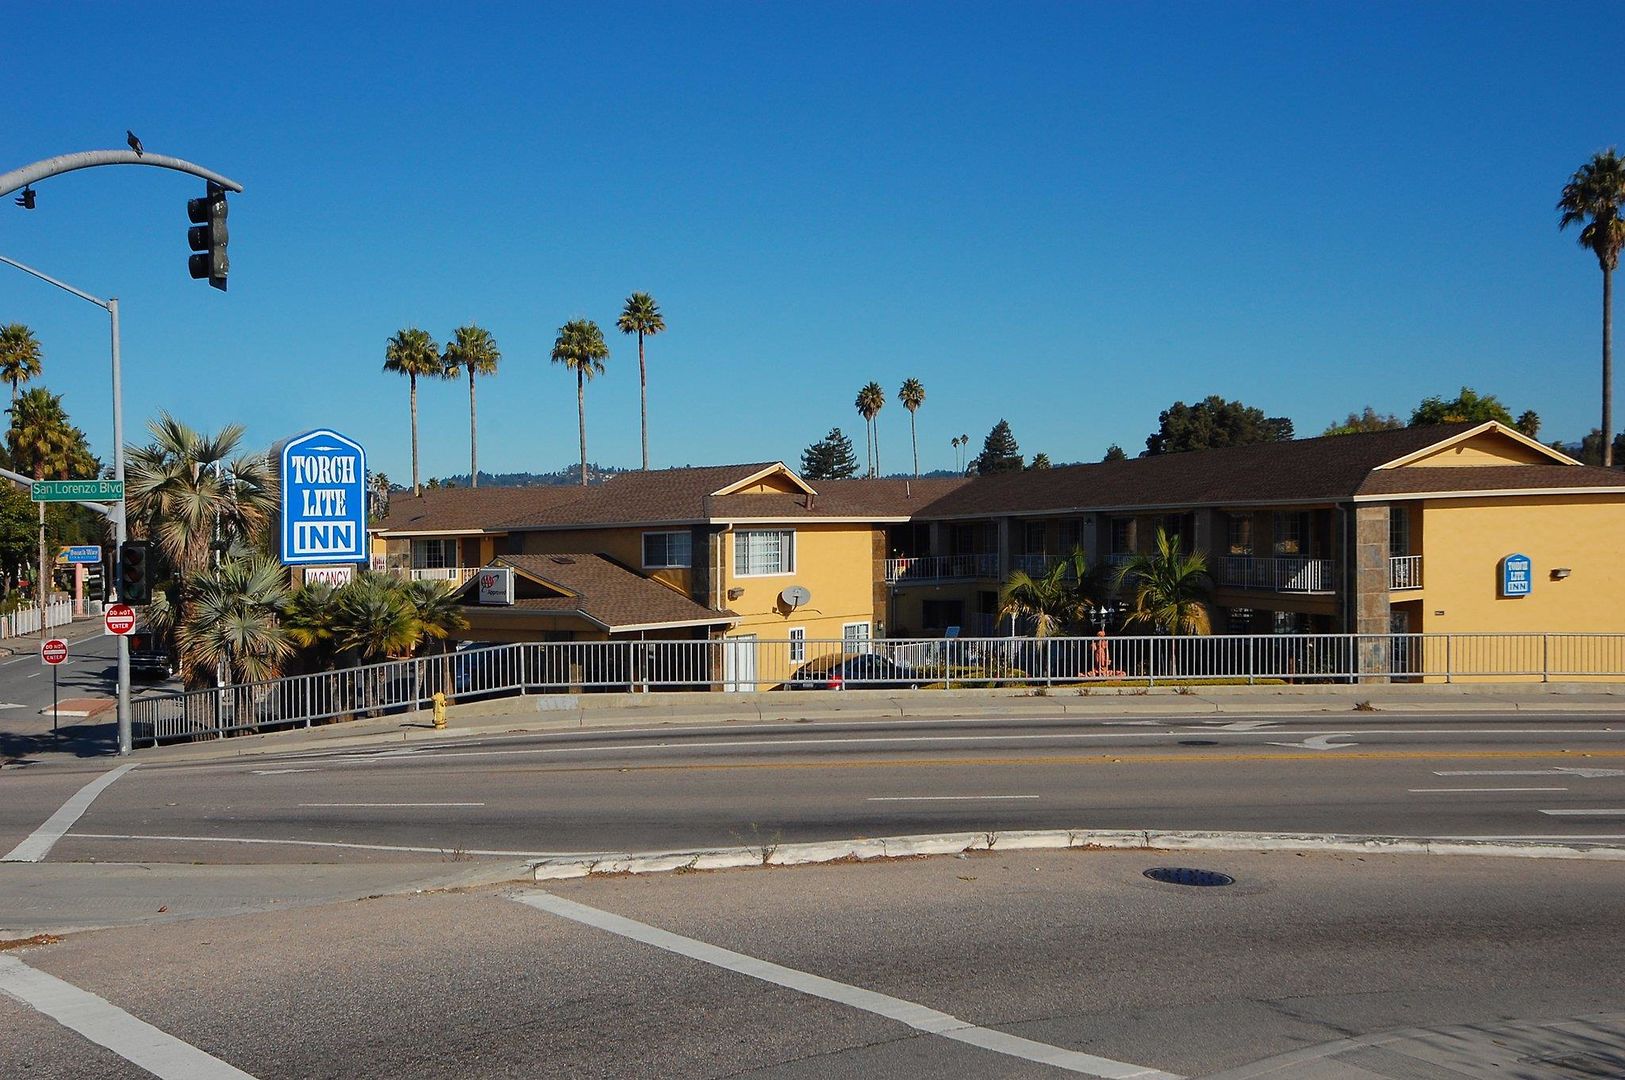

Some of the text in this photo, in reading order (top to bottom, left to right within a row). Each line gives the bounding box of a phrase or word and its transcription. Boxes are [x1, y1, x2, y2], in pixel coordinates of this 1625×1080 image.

[291, 455, 356, 484] TORCH
[33, 482, 122, 494] San Lorenzo Blvd
[302, 489, 347, 517] LITE
[299, 525, 351, 550] INN
[307, 571, 349, 586] VACANCY
